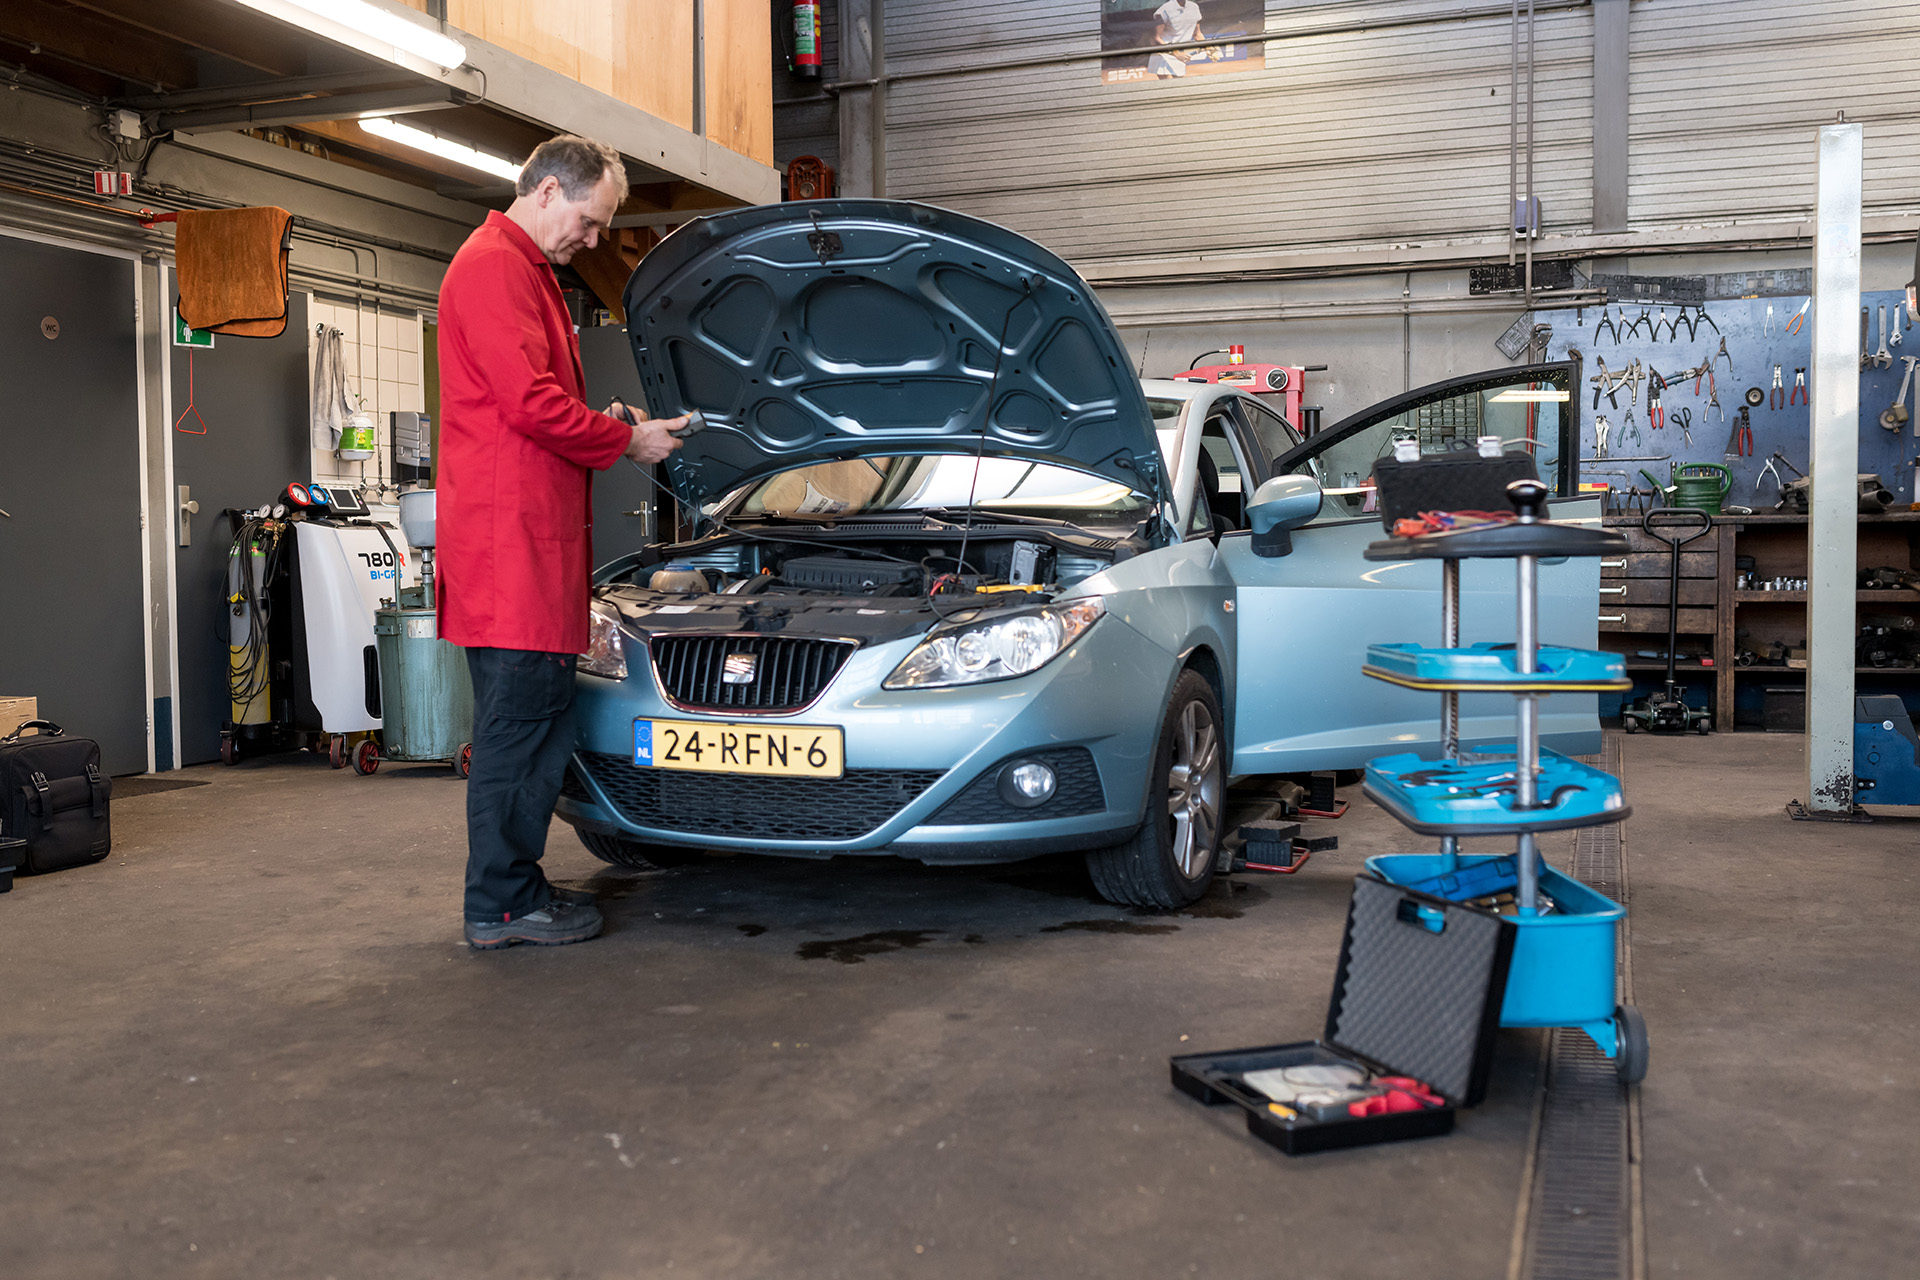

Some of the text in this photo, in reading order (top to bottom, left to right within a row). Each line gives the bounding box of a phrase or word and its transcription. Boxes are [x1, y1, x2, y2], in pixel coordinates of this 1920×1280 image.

[1107, 67, 1146, 82] SEAT
[45, 324, 56, 332] WC
[637, 747, 651, 758] NL
[664, 729, 828, 768] 24-RFN-6
